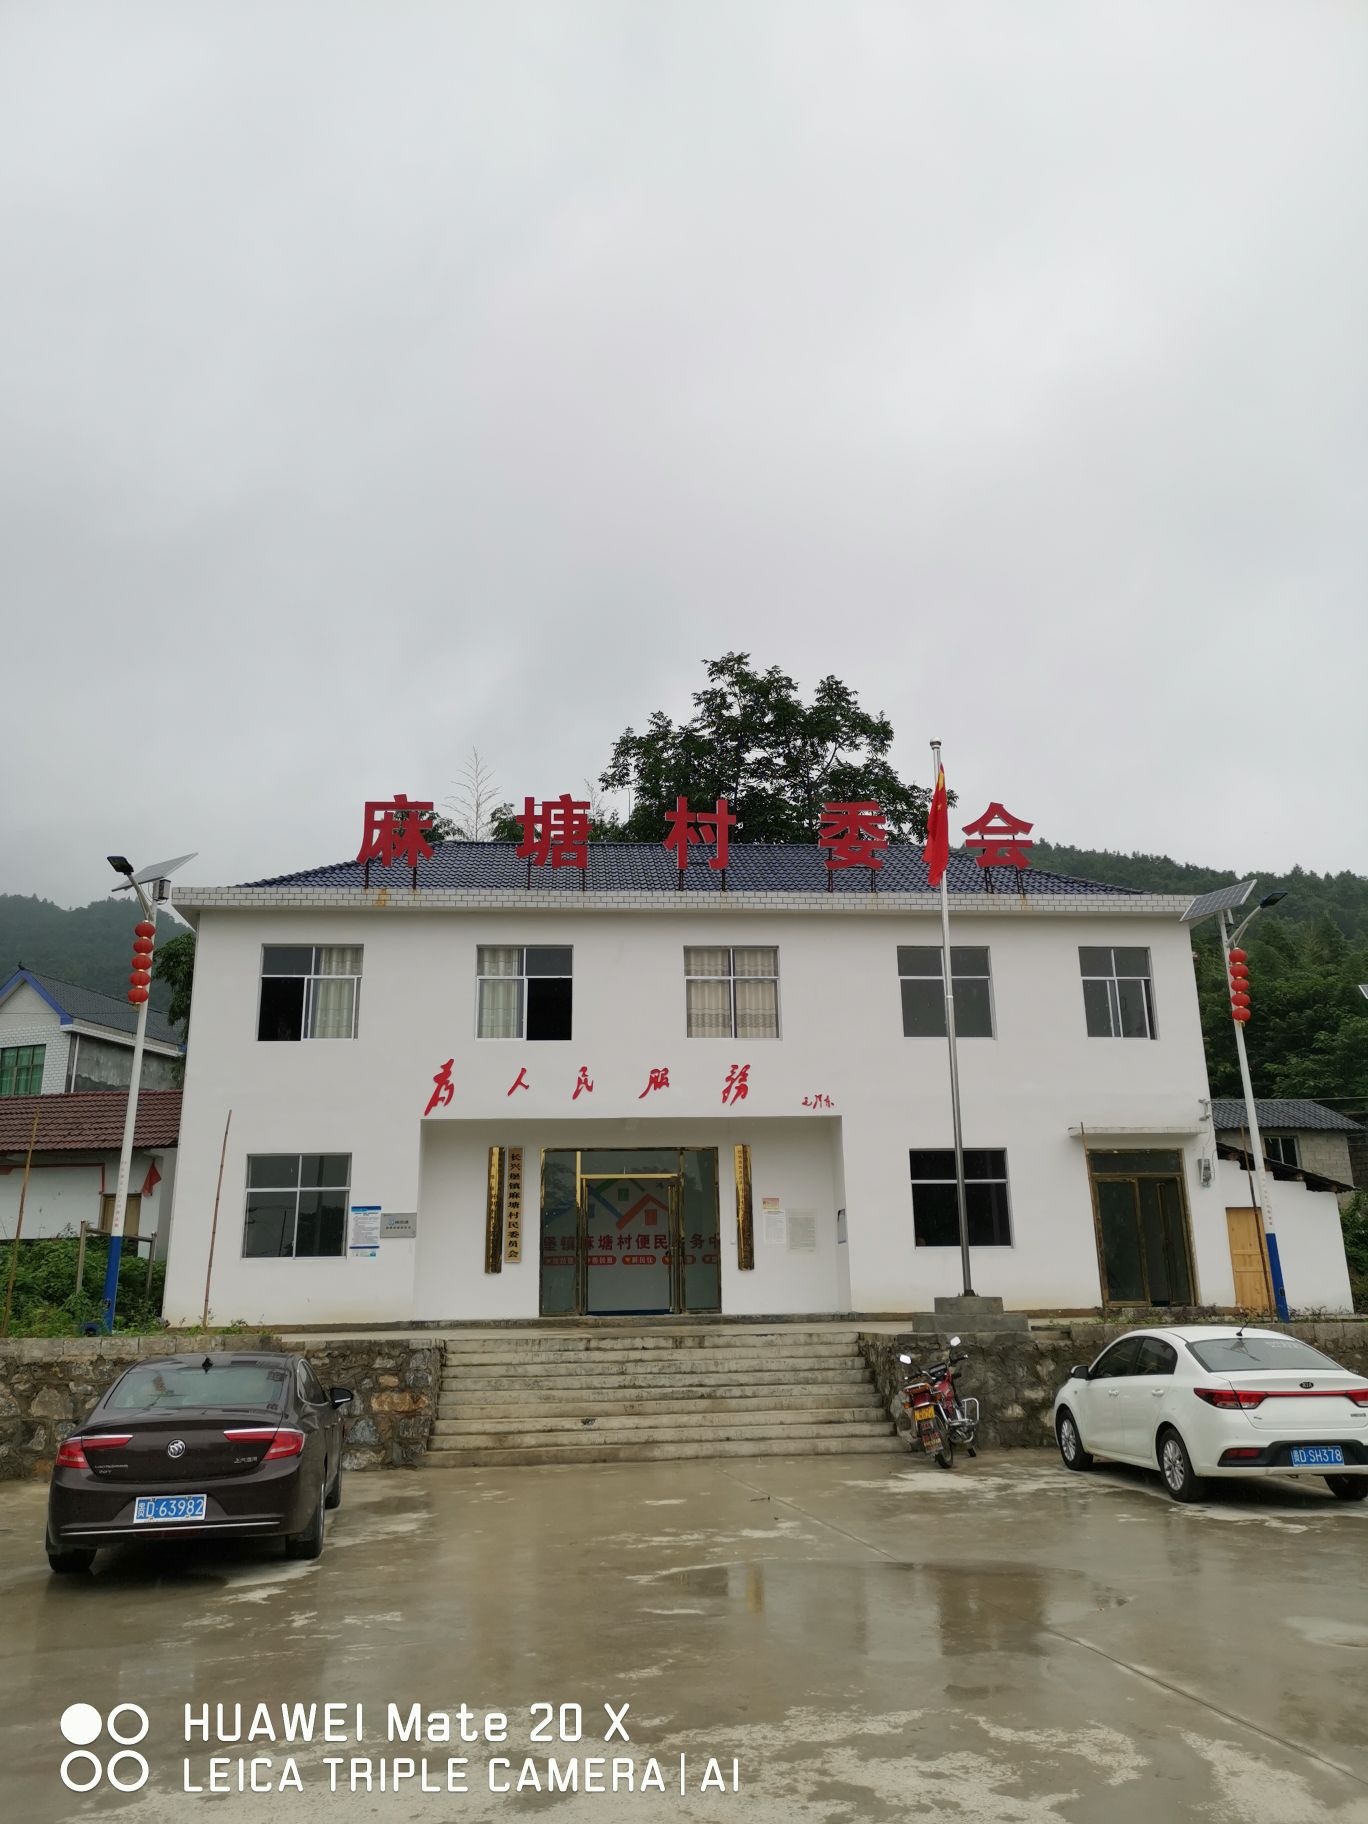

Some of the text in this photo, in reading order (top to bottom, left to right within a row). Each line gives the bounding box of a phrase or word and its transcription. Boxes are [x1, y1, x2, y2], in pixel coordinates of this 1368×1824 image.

[356, 794, 1034, 870] 麻塘村委会
